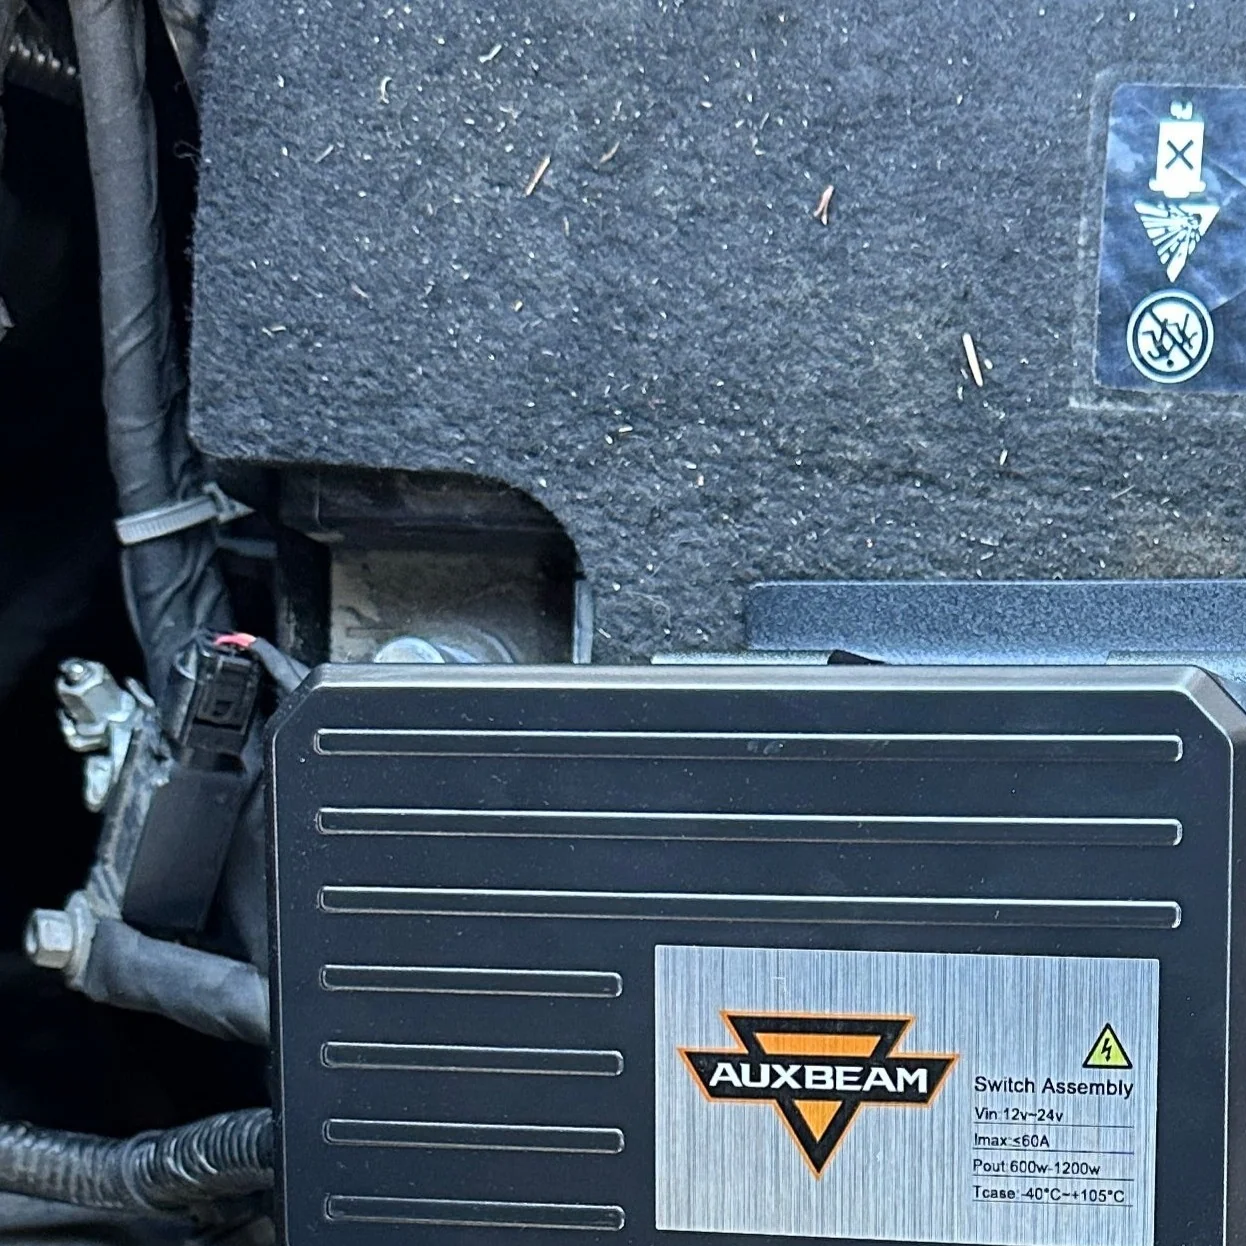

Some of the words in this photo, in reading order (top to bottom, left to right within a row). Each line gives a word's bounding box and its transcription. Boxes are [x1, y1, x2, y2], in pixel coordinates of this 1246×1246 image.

[709, 1059, 928, 1094] AUXBEAM
[974, 1076, 1035, 1093] Switch
[1042, 1078, 1134, 1100] Assembly
